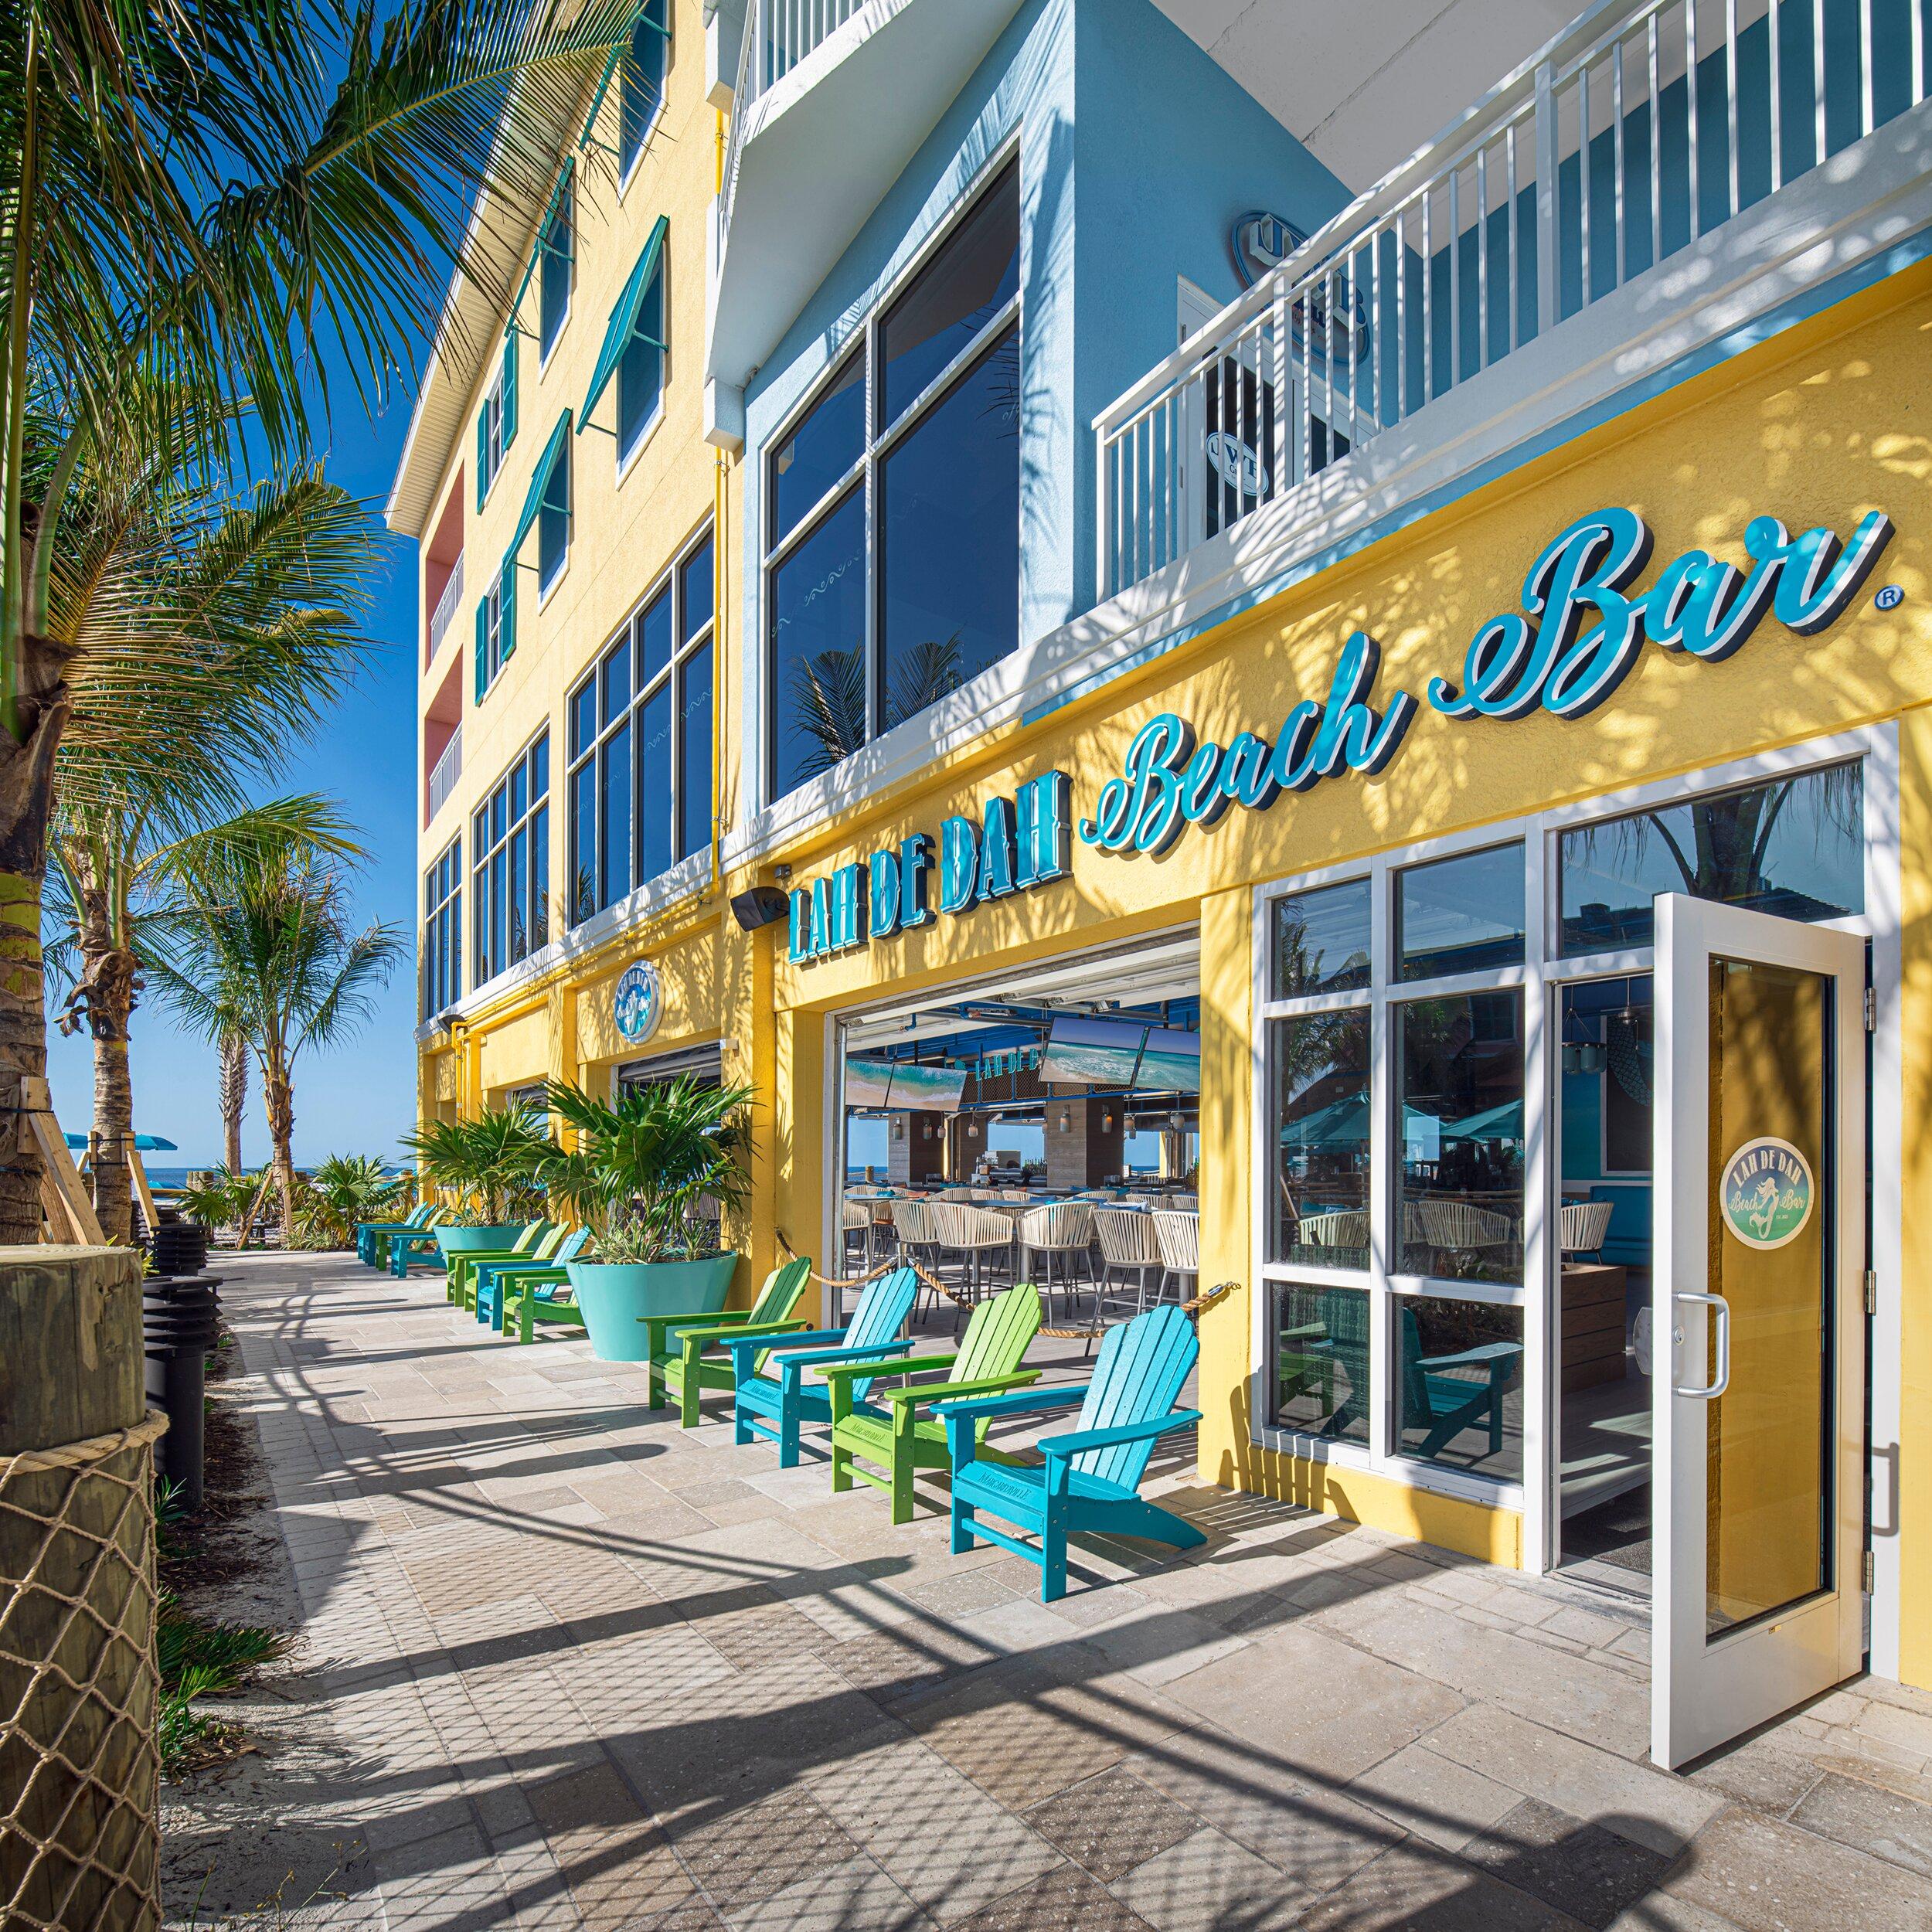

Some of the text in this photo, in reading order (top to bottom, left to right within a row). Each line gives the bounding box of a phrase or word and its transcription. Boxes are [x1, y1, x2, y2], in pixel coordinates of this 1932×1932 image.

[788, 862, 869, 965] LAH
[870, 833, 937, 940] DE
[940, 769, 1073, 916] DAH
[1079, 631, 1419, 855] Beach
[1428, 507, 1896, 721] Bar
[975, 1054, 1002, 1081] LAH
[1008, 1050, 1024, 1073] DE
[1733, 1149, 1802, 1188] LAH DE DAH
[1729, 1189, 1805, 1213] Beach Bar
